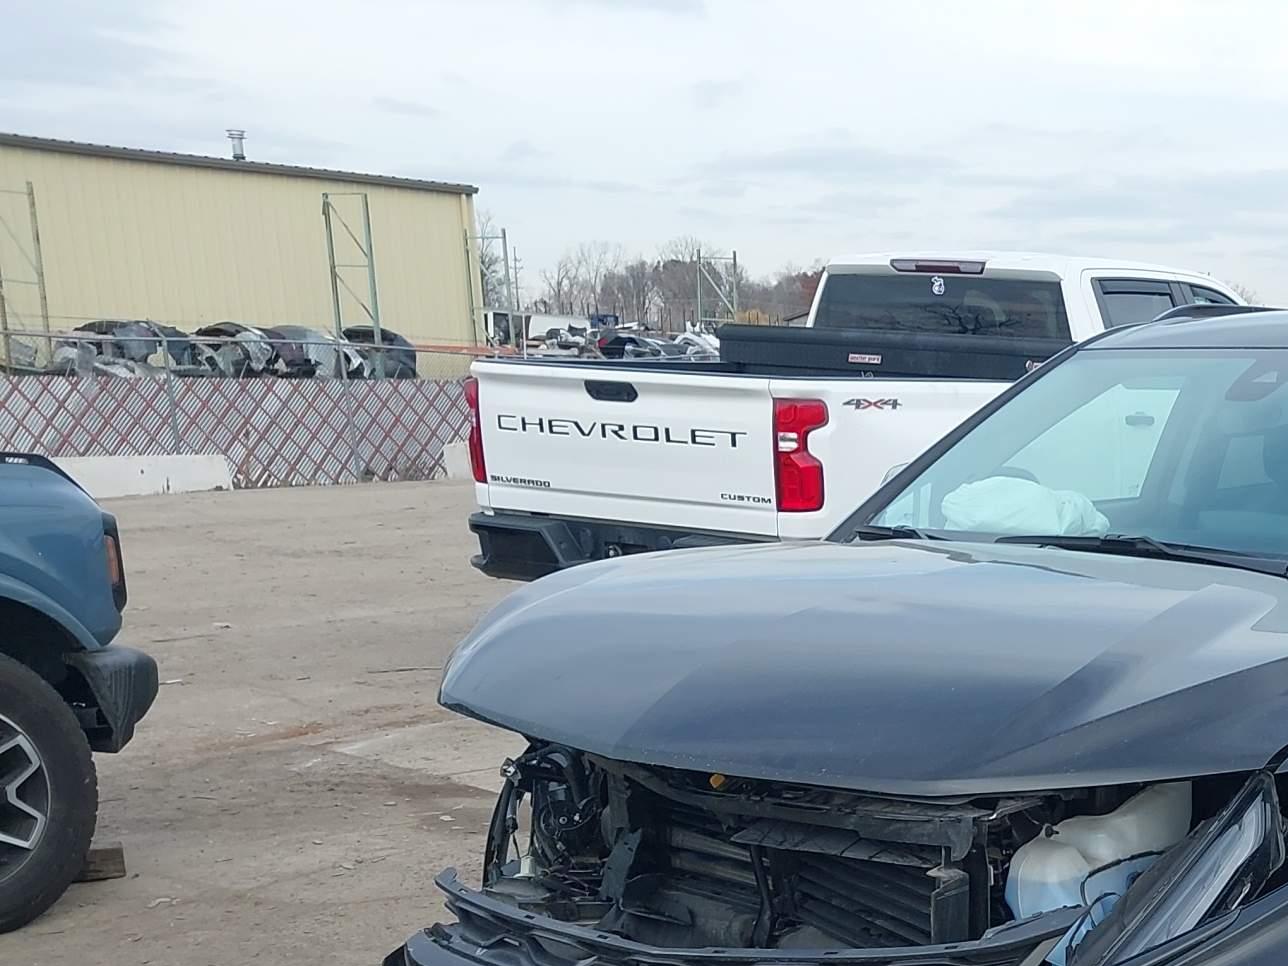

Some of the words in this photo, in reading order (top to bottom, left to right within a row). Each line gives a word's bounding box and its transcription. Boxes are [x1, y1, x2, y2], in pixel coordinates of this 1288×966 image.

[496, 414, 748, 448] CHEVROLET
[490, 474, 551, 488] SILVERADO
[720, 493, 772, 504] CUSTOM
